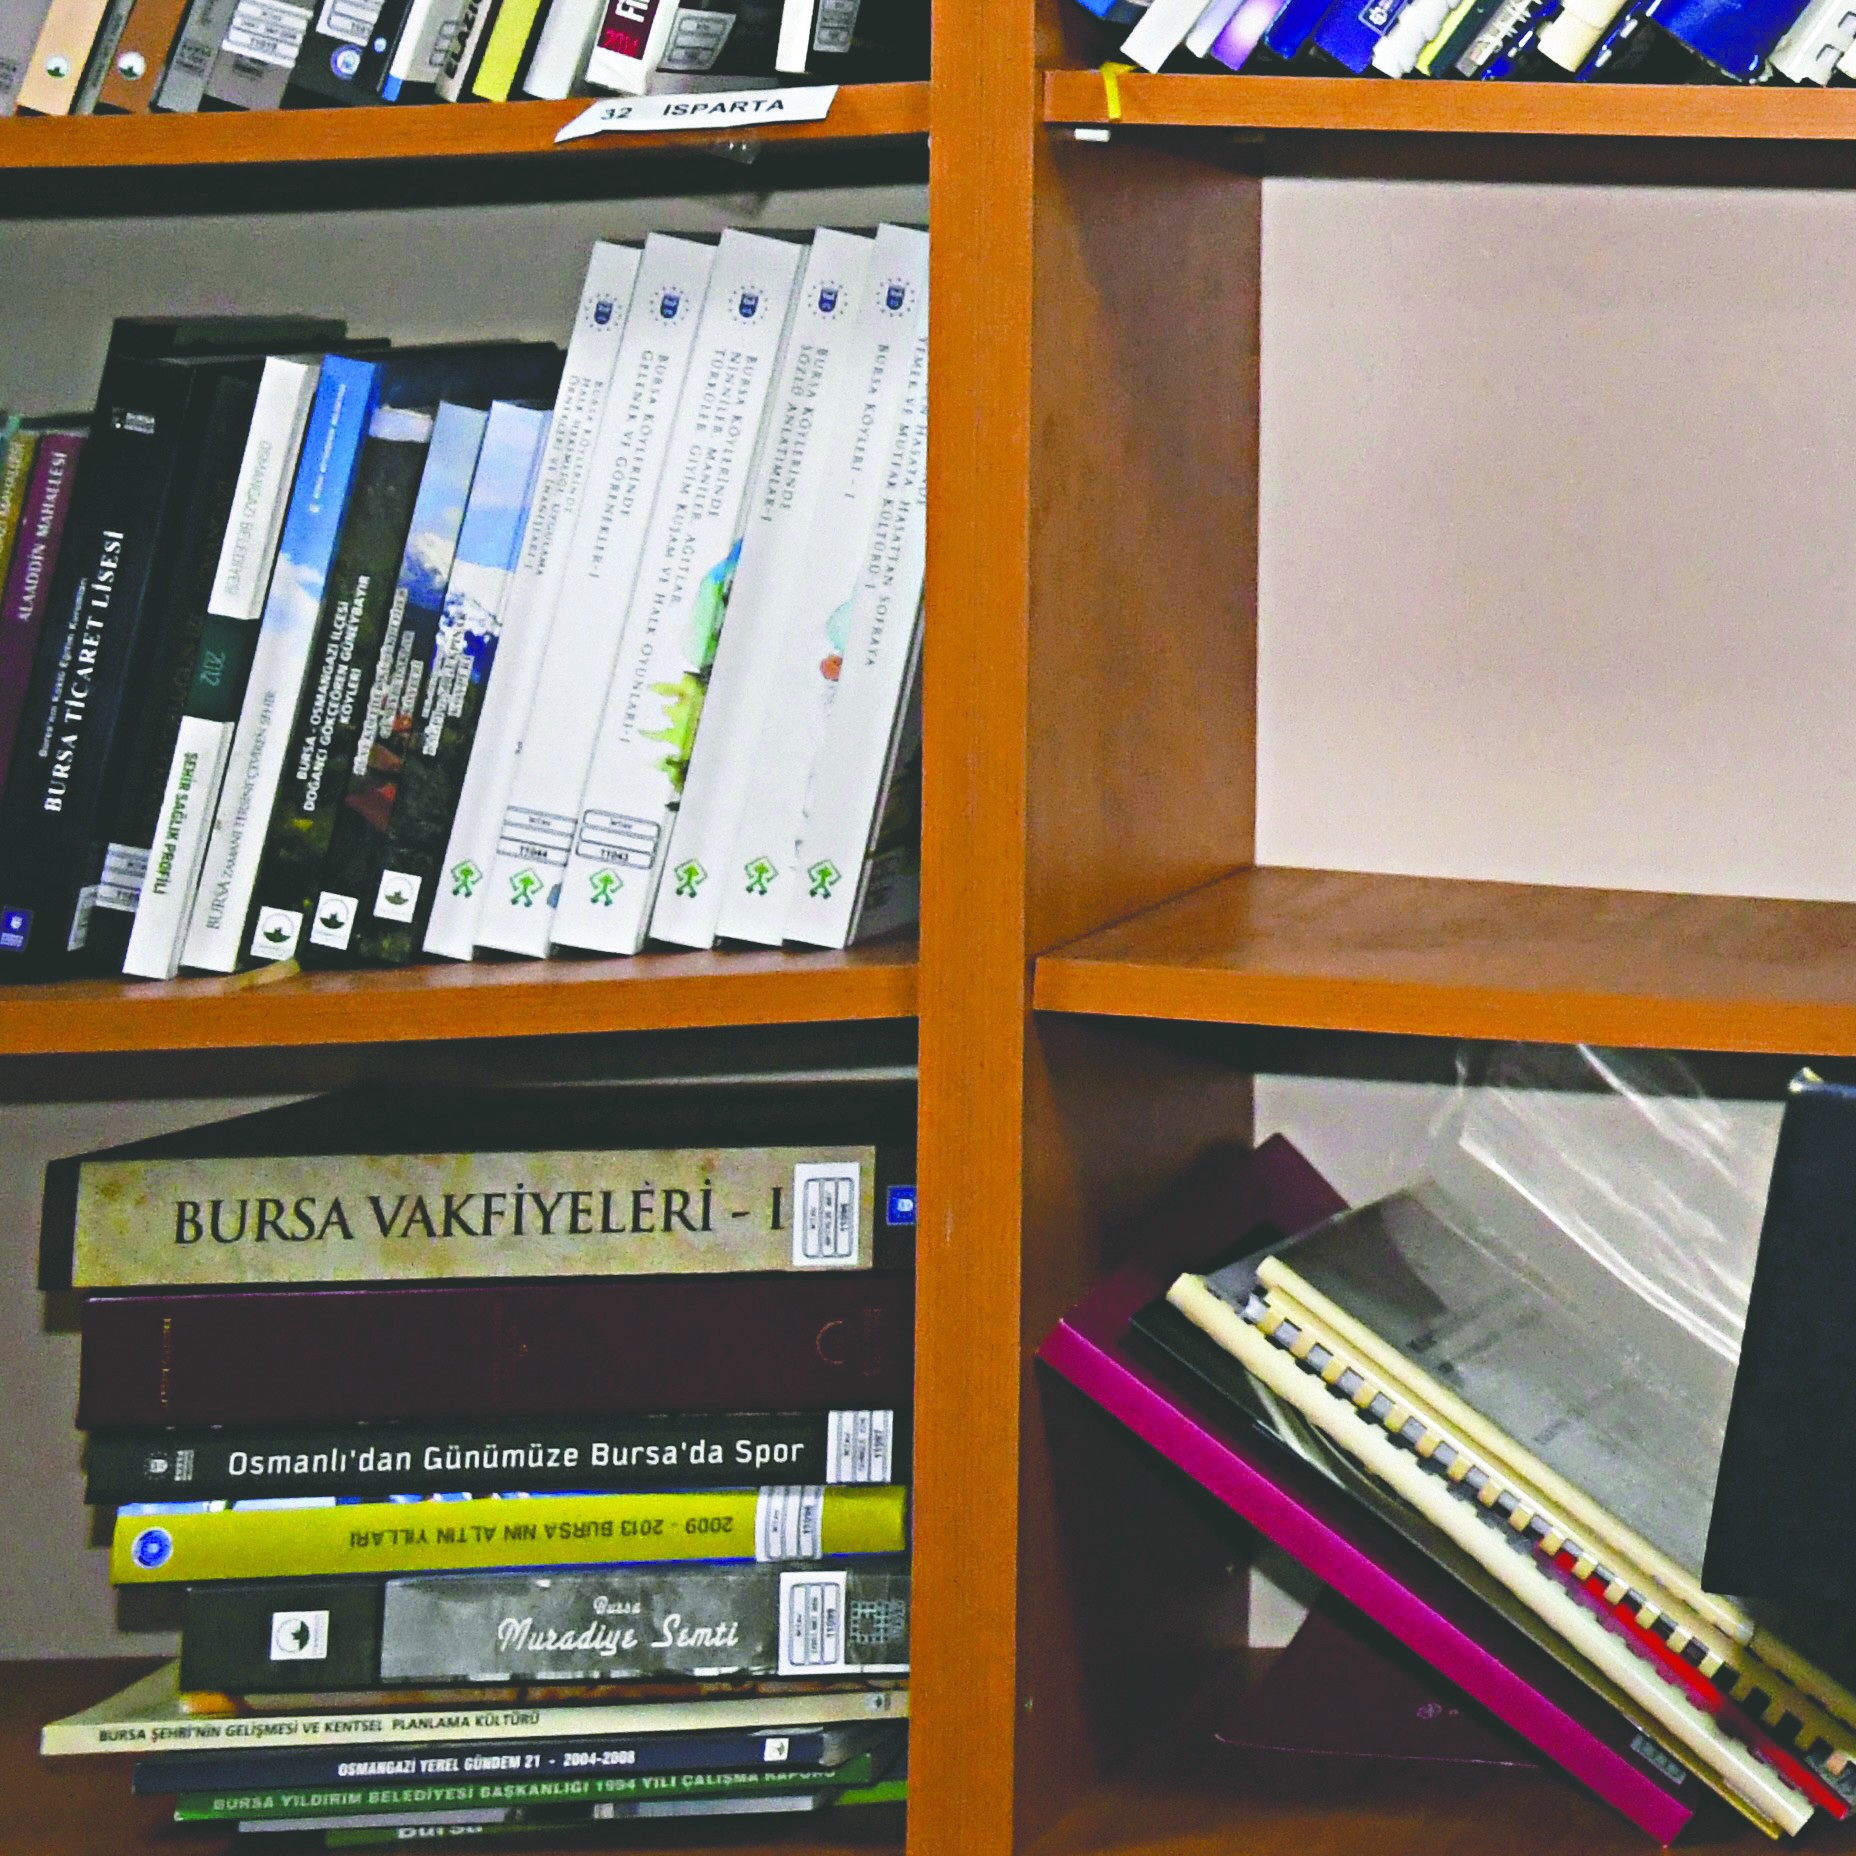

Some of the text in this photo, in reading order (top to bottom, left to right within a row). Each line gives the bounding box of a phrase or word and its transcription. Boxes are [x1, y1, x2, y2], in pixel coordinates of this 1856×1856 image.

[601, 98, 784, 119] 32 ISPARTA
[40, 528, 125, 812] BURSA TİCARET LİSESİ
[174, 1195, 354, 1246] BURSA
[768, 1185, 784, 1231] I
[228, 1438, 805, 1476] Osmanlı'dan Günümüze Bursa'da Spor
[498, 1612, 738, 1657] Muradiye Semti
